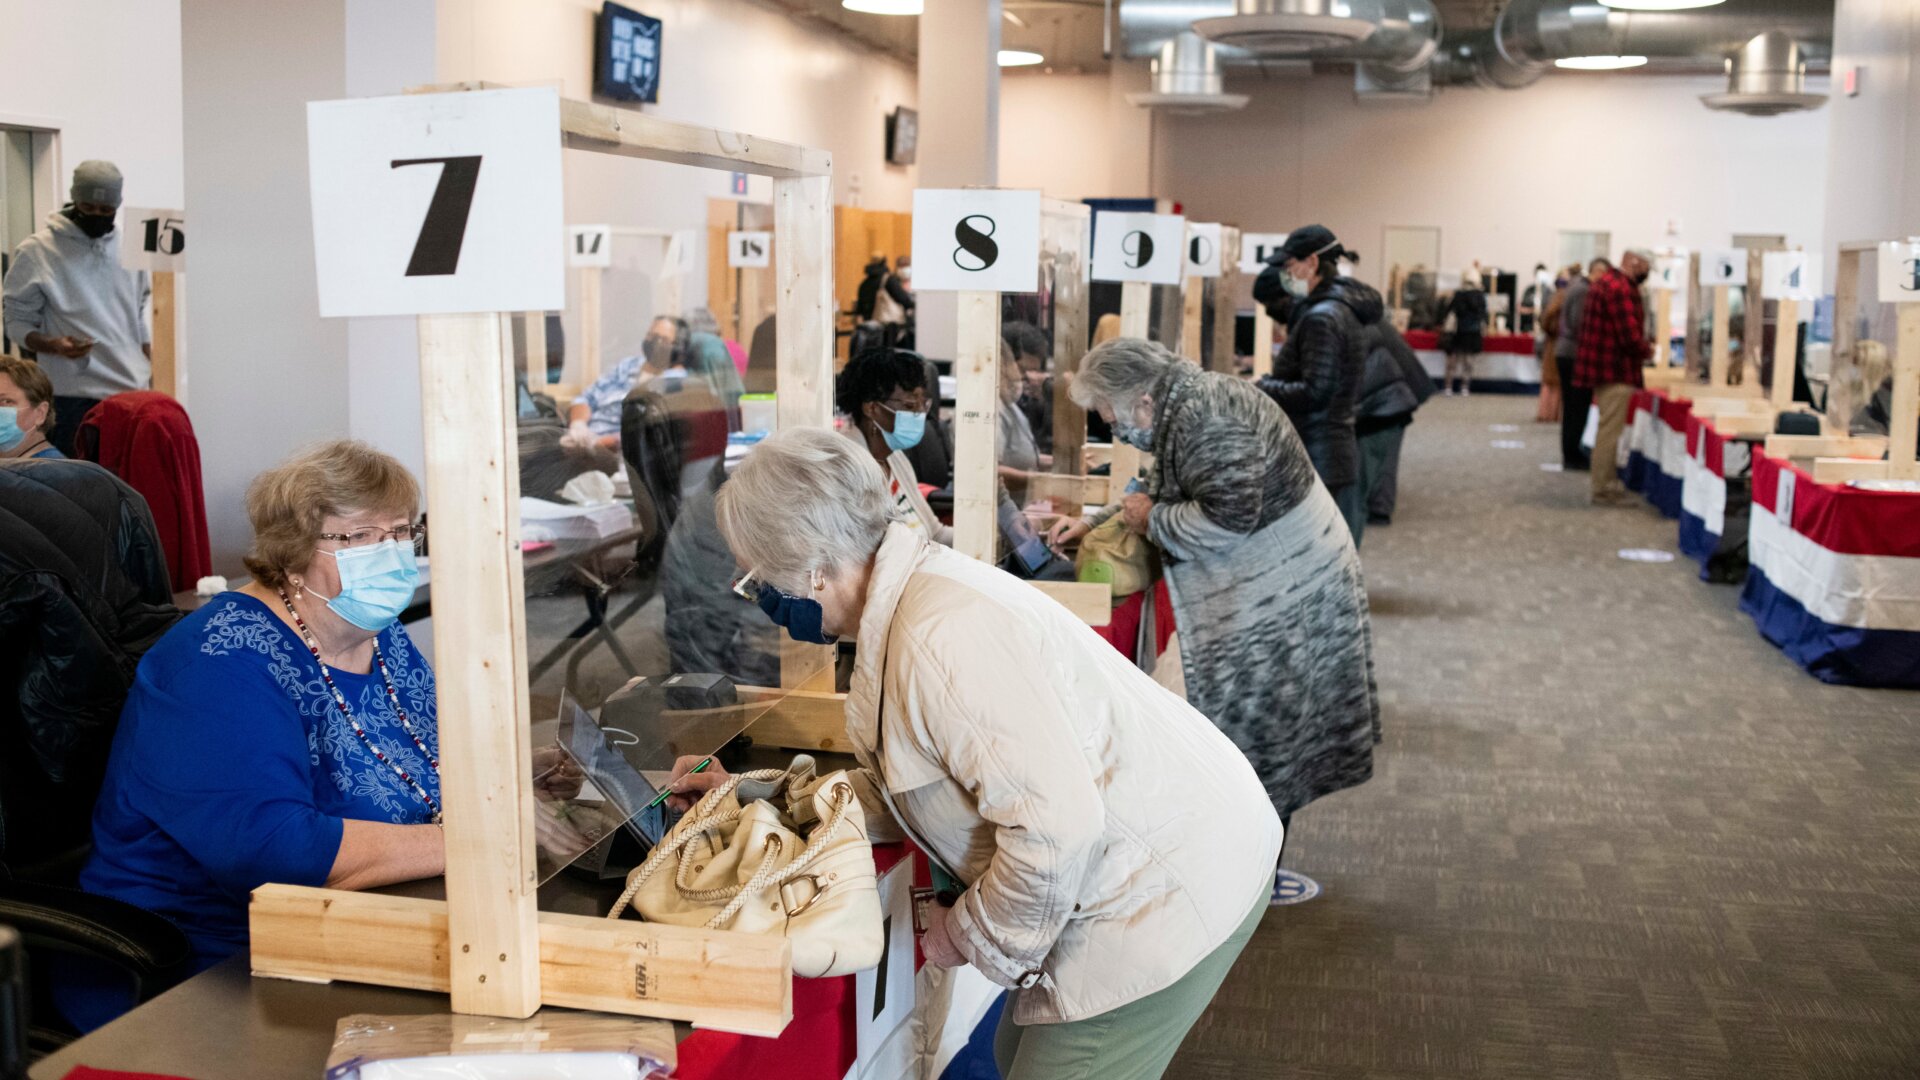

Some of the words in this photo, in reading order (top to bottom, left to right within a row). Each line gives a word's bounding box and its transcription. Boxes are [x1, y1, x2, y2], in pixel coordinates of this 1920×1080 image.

[390, 154, 483, 277] 7
[141, 217, 185, 255] 15
[574, 233, 603, 254] 17
[740, 240, 763, 257] 18
[953, 214, 998, 271] 8
[1121, 230, 1154, 269] 9
[1189, 235, 1213, 266] 0
[636, 940, 648, 951] 2
